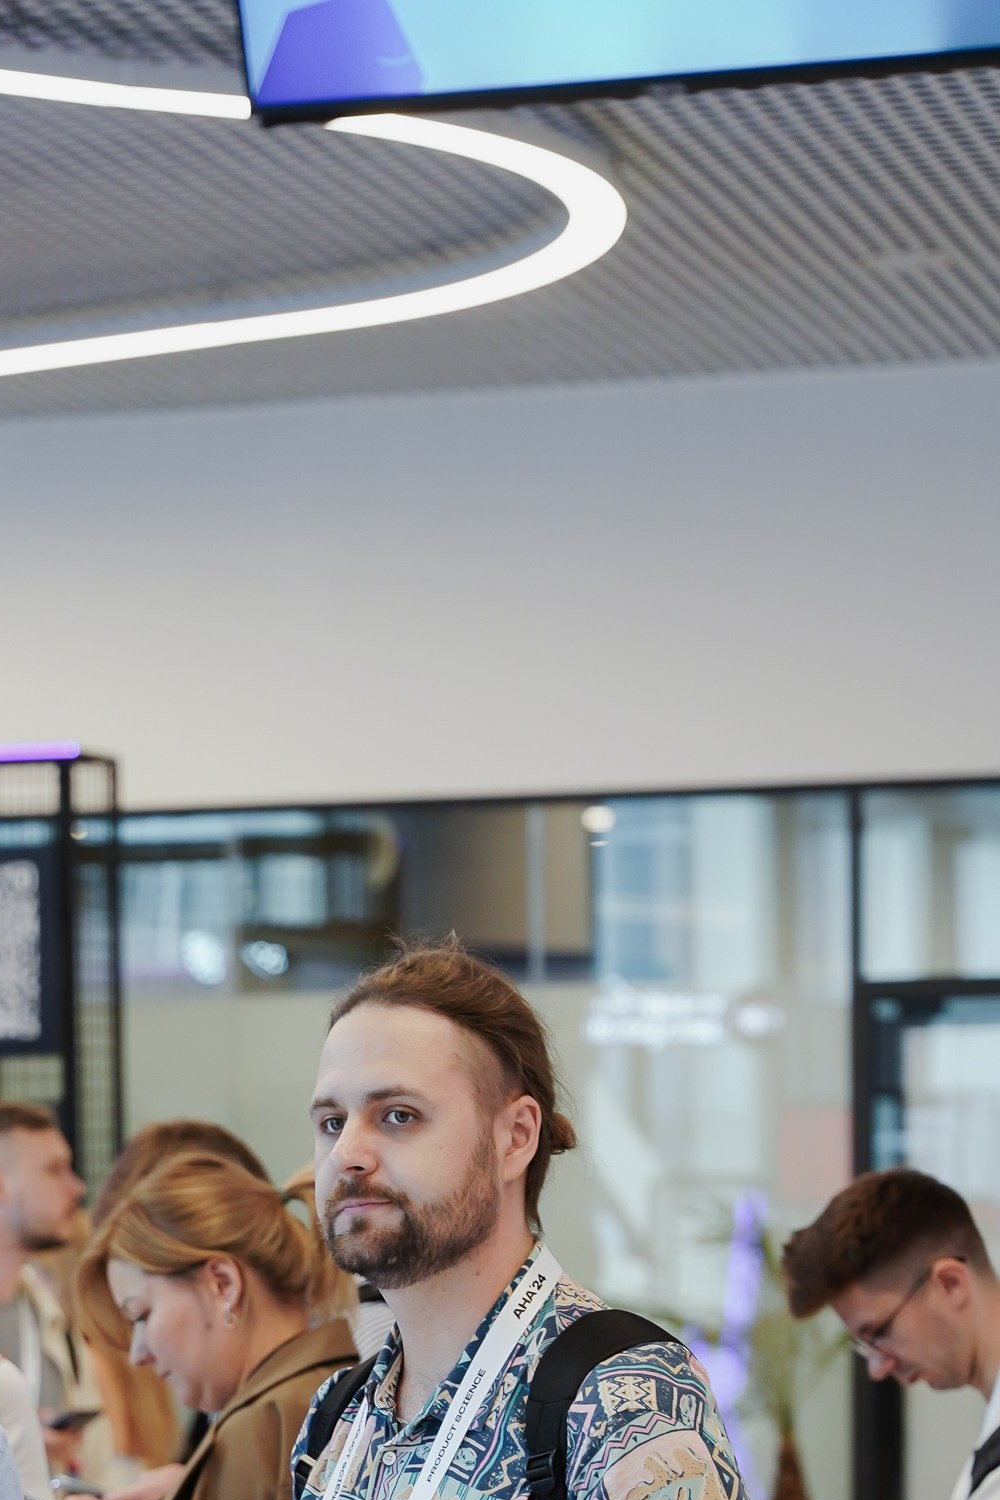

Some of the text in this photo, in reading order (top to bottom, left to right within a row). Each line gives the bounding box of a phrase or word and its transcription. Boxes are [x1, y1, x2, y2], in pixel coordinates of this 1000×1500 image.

[513, 1273, 547, 1320] AHA'24
[426, 1368, 486, 1482] PRODUCT SCIENCE
